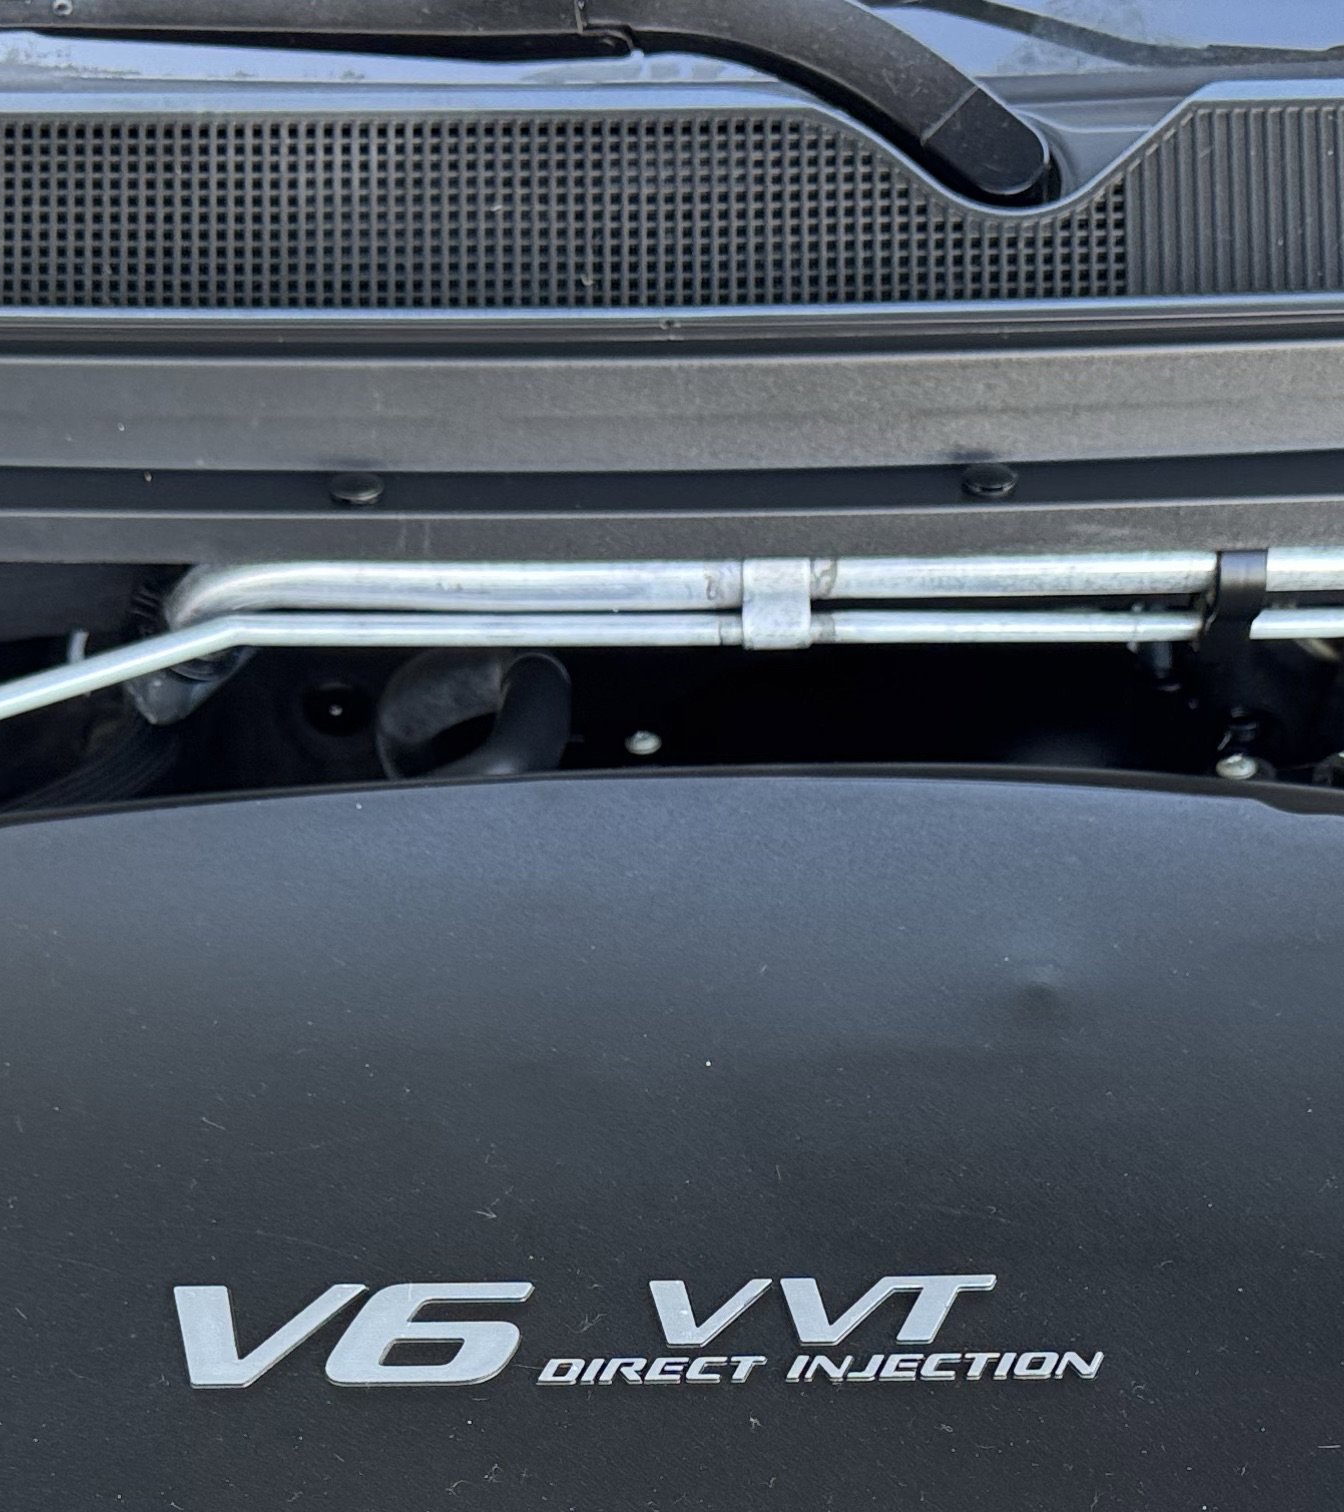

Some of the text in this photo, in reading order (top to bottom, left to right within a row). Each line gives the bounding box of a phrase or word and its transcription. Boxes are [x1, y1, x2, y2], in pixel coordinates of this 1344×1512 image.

[173, 1282, 535, 1388] V6
[648, 1274, 997, 1347] VVT
[536, 1350, 1105, 1385] DIRECT INJECTION
